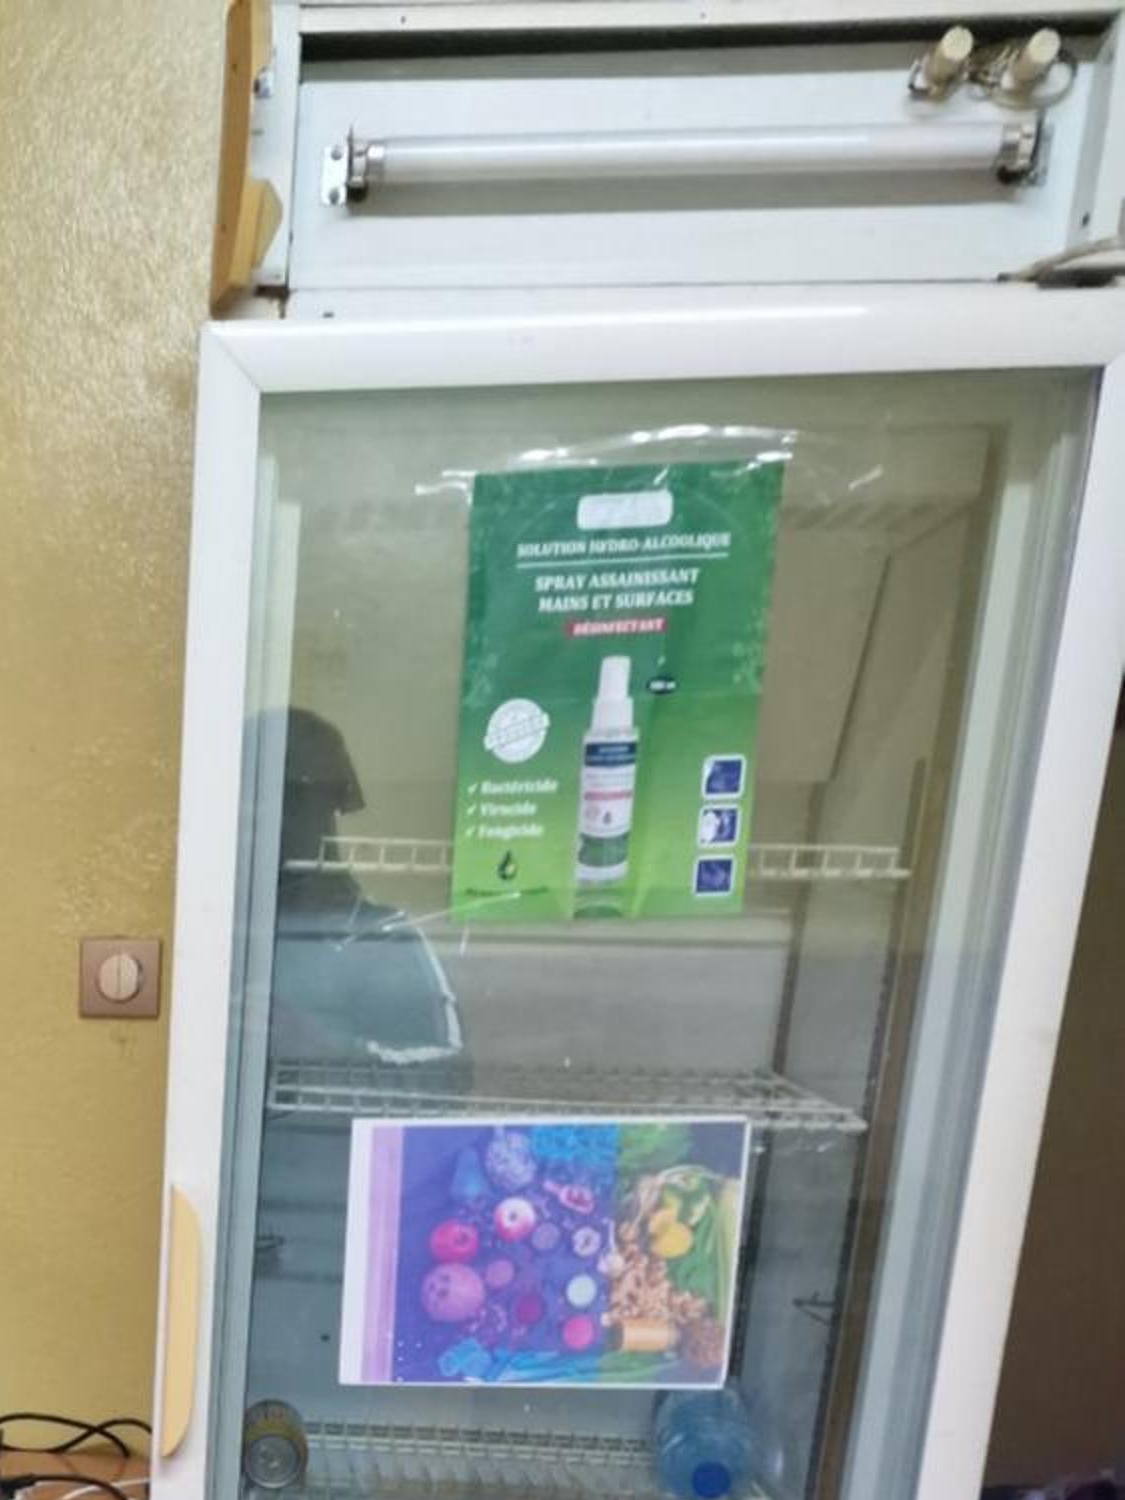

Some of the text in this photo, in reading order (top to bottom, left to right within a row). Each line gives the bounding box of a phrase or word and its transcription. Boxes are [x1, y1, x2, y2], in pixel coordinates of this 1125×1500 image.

[516, 541, 586, 558] SOLUTION
[536, 568, 699, 592] SPRAY ASSAINISSANT
[539, 589, 694, 613] MAINS ET SURFACES
